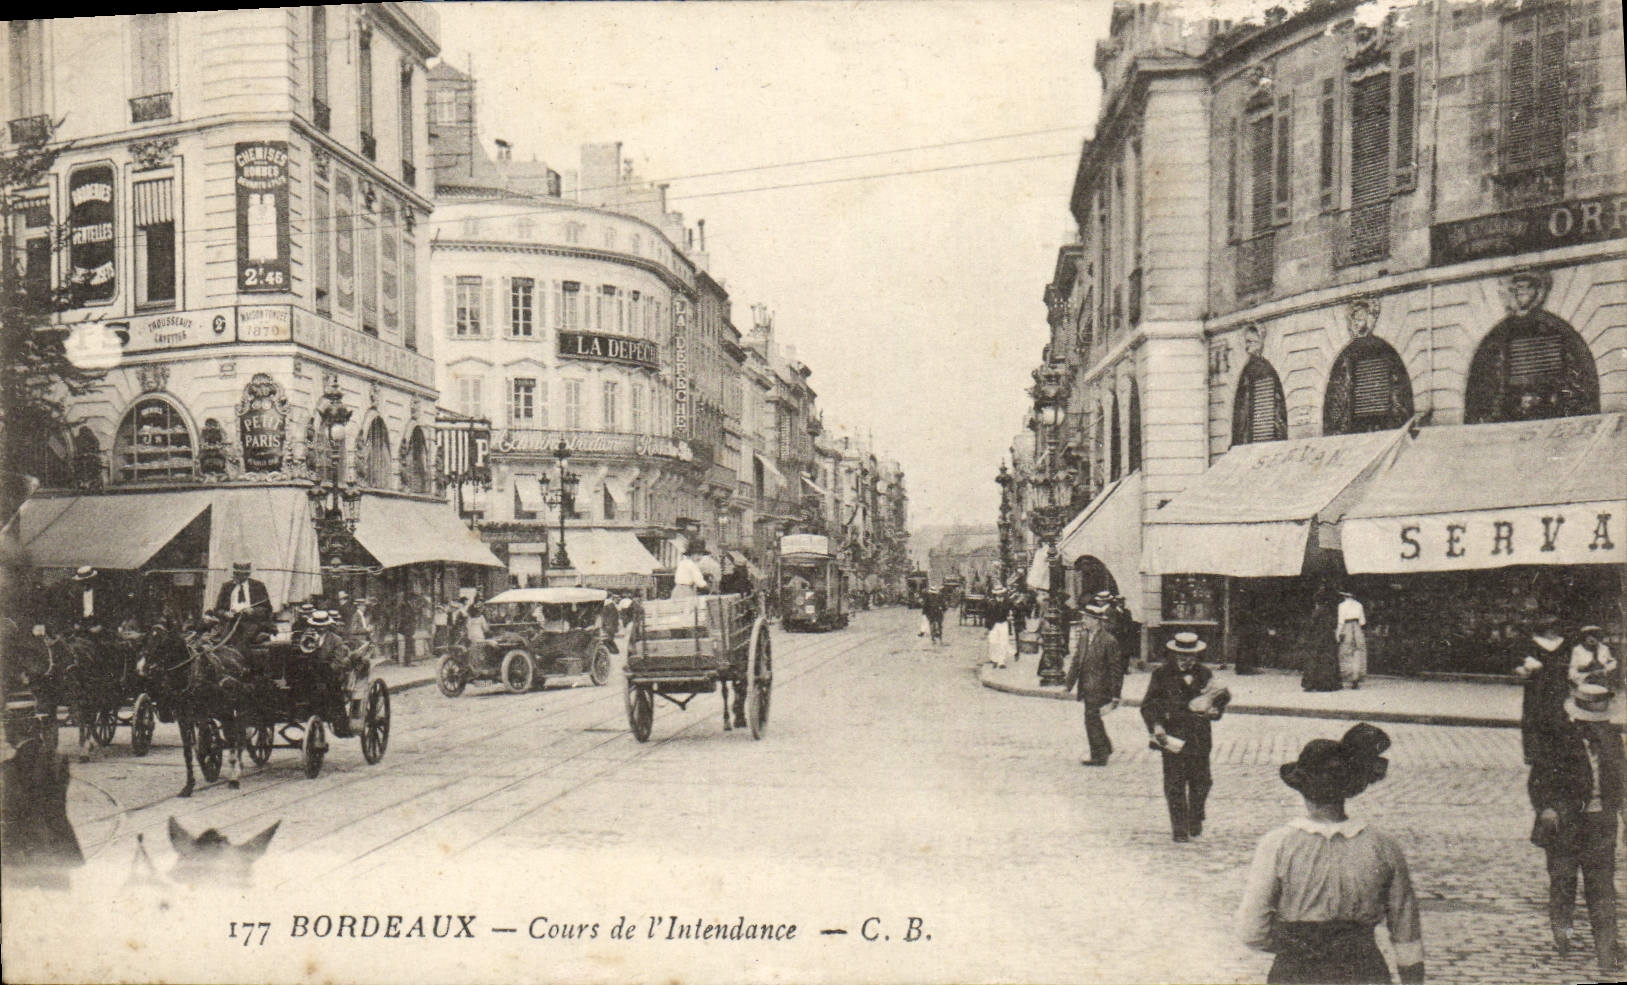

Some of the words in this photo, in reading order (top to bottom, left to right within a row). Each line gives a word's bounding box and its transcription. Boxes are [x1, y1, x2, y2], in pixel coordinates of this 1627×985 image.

[236, 147, 288, 167] CHEMISES
[577, 336, 602, 356] LA
[607, 338, 658, 363] DEPECH
[243, 414, 283, 432] PETIT
[245, 434, 281, 448] PARIS
[475, 439, 489, 467] P
[1400, 510, 1615, 560] SERVA
